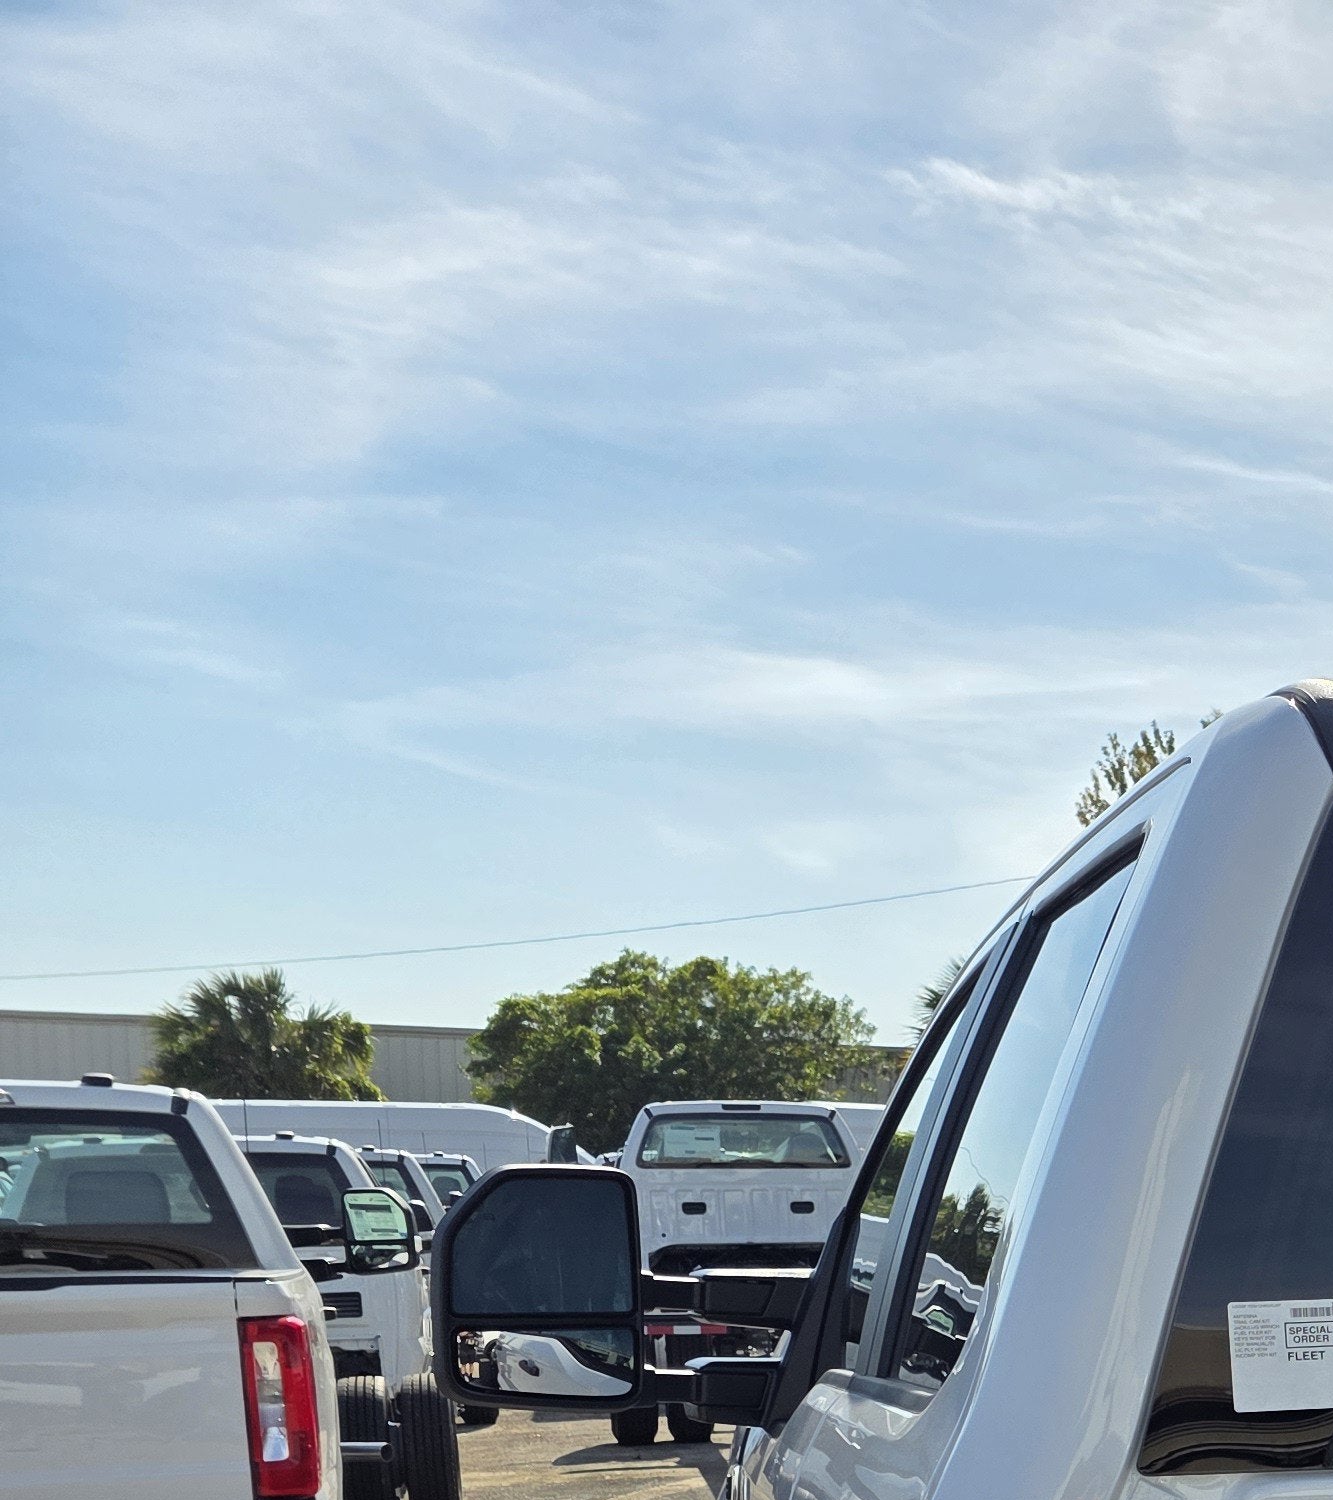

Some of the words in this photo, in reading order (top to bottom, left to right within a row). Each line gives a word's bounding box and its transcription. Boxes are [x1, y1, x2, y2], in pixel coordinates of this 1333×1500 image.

[1288, 1325, 1333, 1335] SPECIAL
[1293, 1335, 1330, 1344] ORDER
[1287, 1351, 1326, 1361] FLEET
